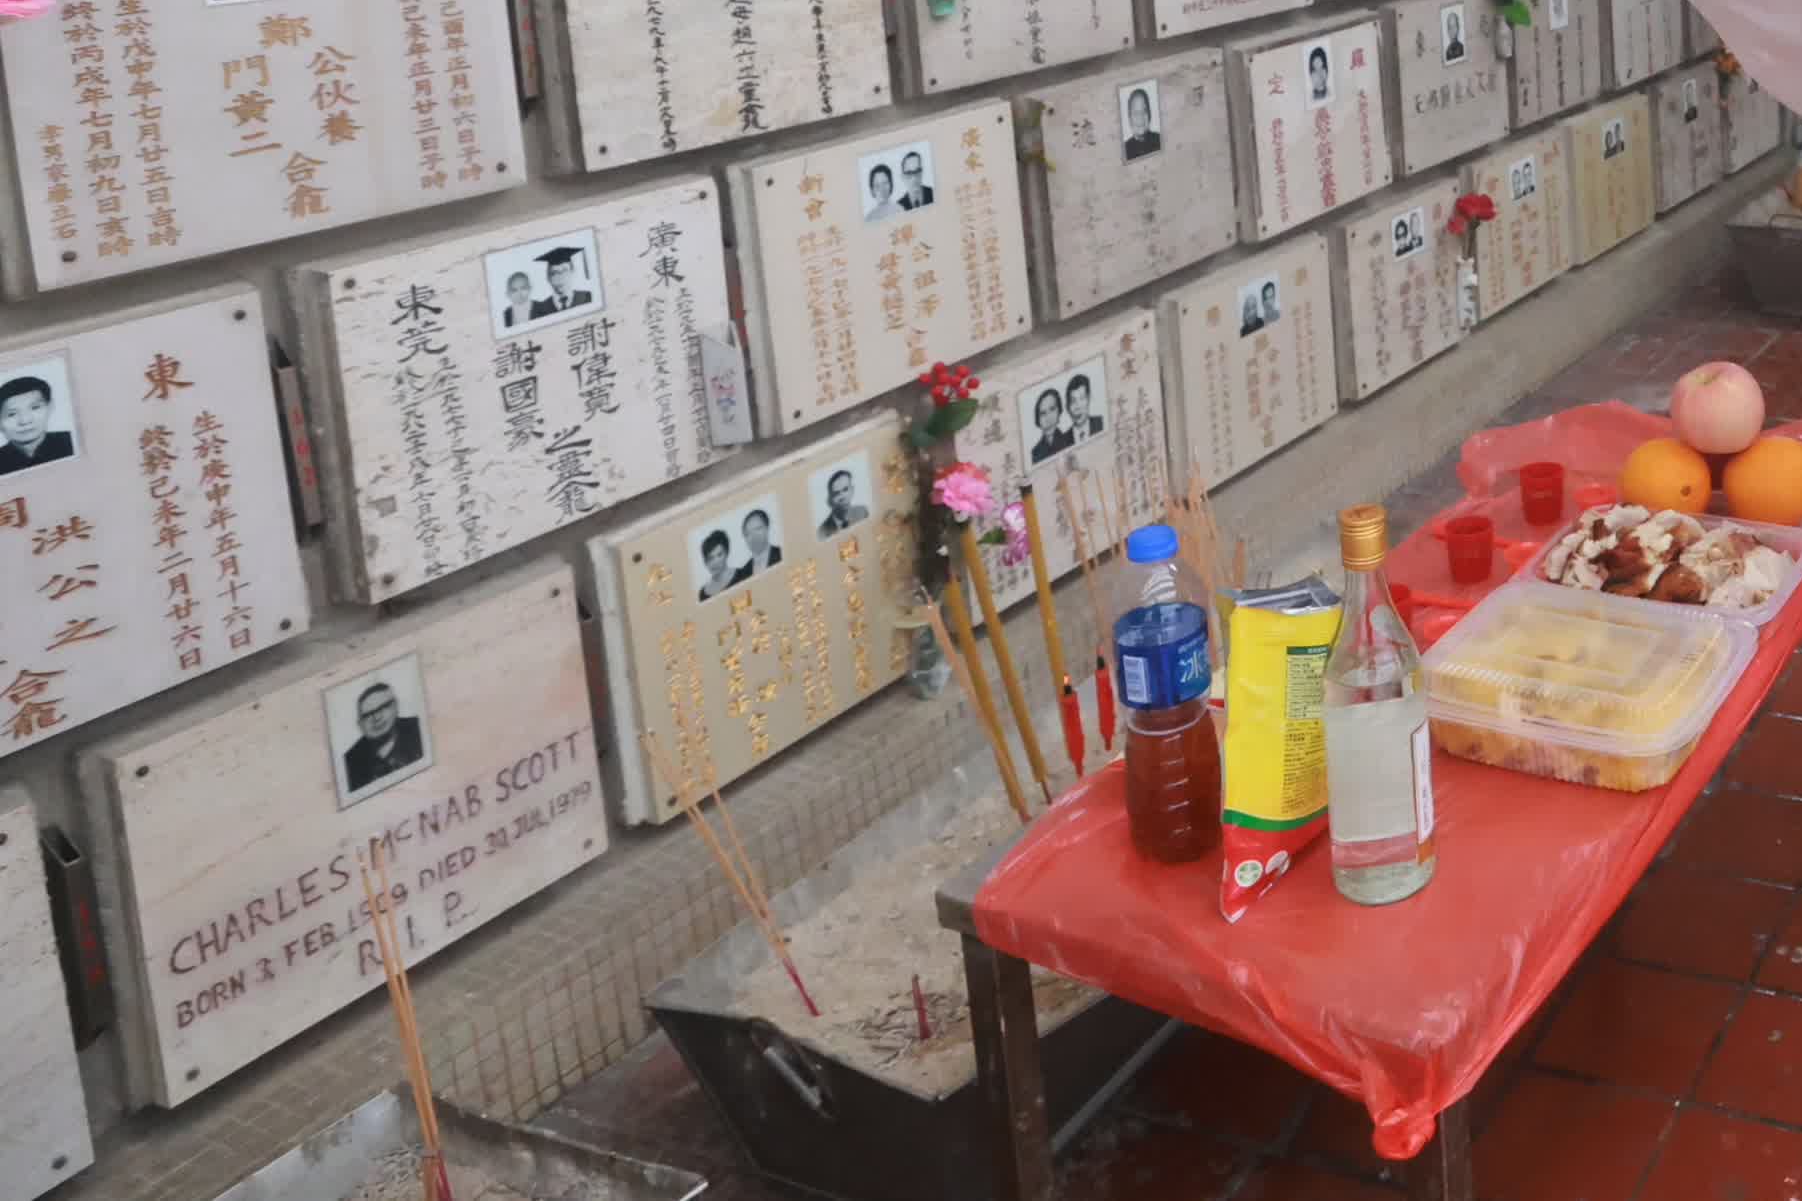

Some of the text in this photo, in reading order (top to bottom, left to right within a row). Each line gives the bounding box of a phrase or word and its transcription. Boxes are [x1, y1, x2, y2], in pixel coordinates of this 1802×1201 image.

[141, 352, 195, 400] 東
[169, 853, 351, 975] CHARLES
[495, 730, 581, 803] SCOTT
[175, 968, 247, 1030] BORN
[282, 921, 337, 968] FEB
[418, 844, 477, 891] DIED
